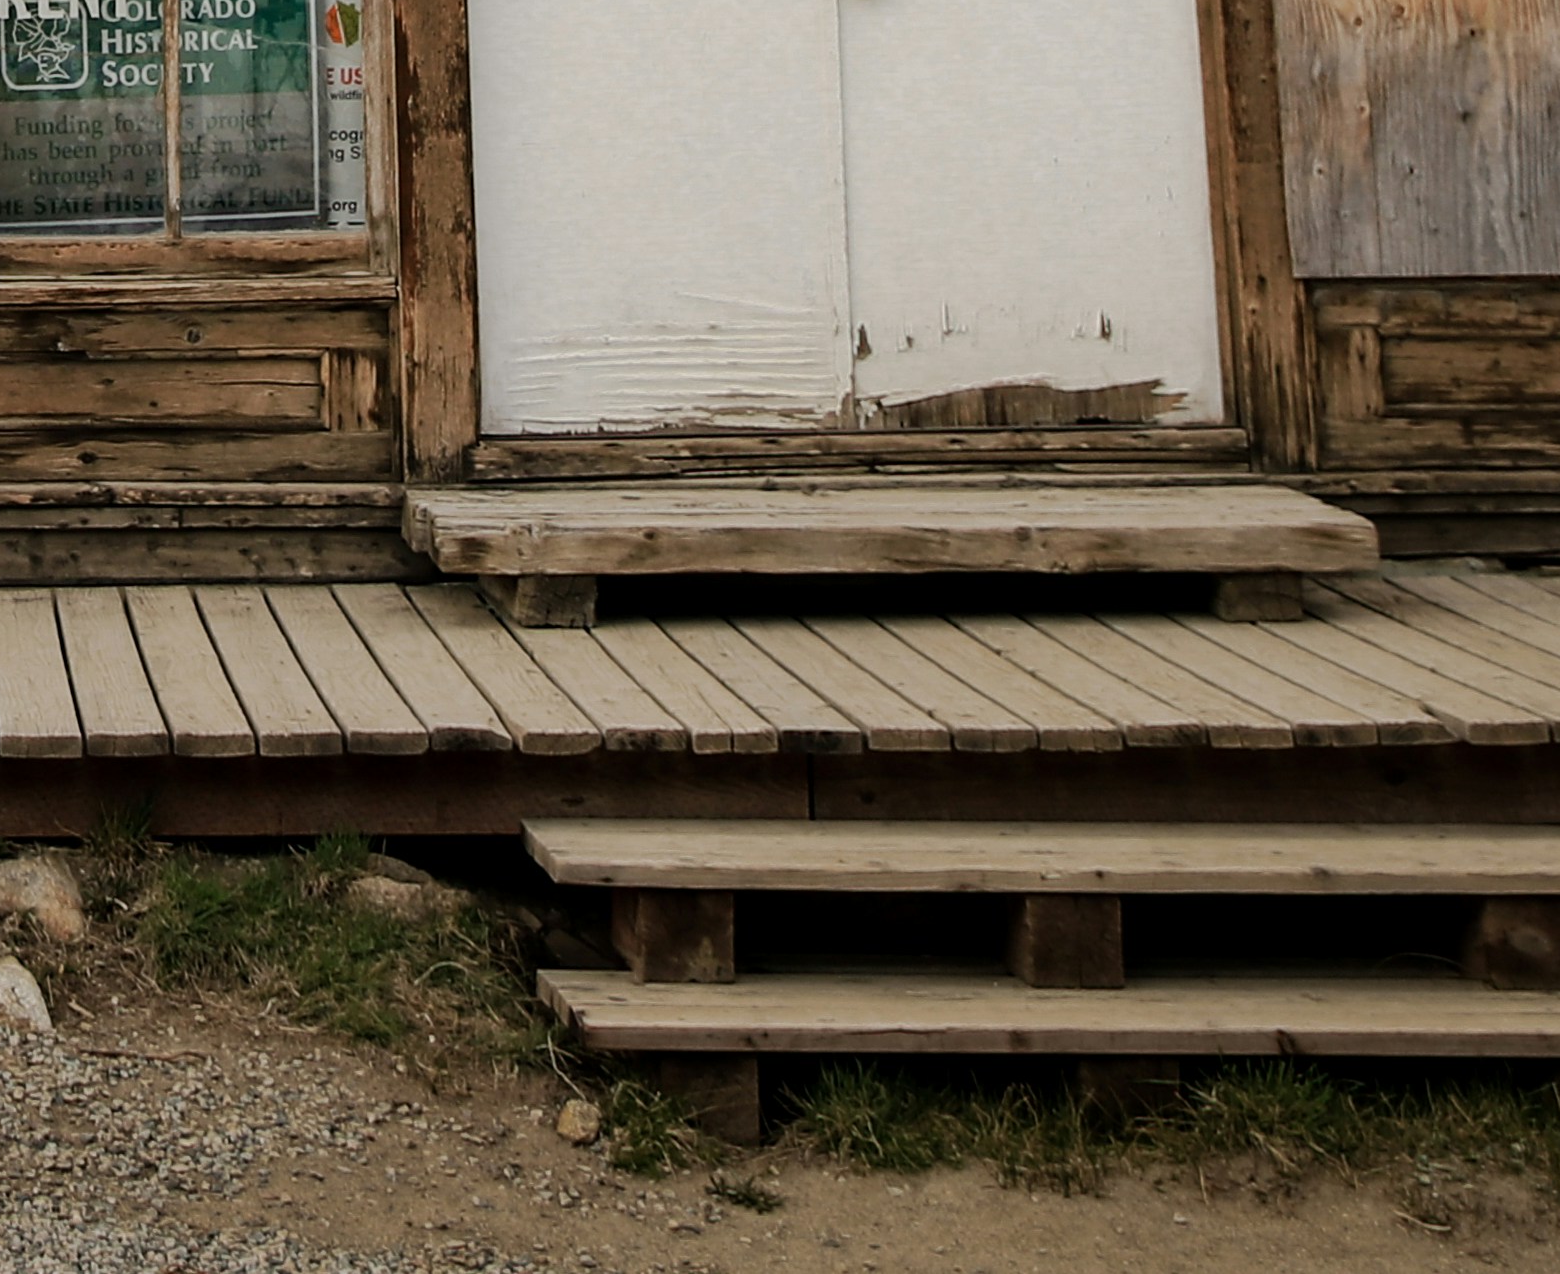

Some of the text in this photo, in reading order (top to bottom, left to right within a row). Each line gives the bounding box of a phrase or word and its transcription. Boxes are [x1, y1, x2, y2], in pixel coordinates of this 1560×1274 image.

[101, 29, 259, 54] HISTRICAL
[15, 114, 104, 140] Funding
[2, 141, 38, 162] has
[48, 140, 97, 160] been
[109, 135, 203, 164] provied
[30, 163, 113, 190] through
[123, 170, 135, 182] a
[34, 193, 94, 215] STATE
